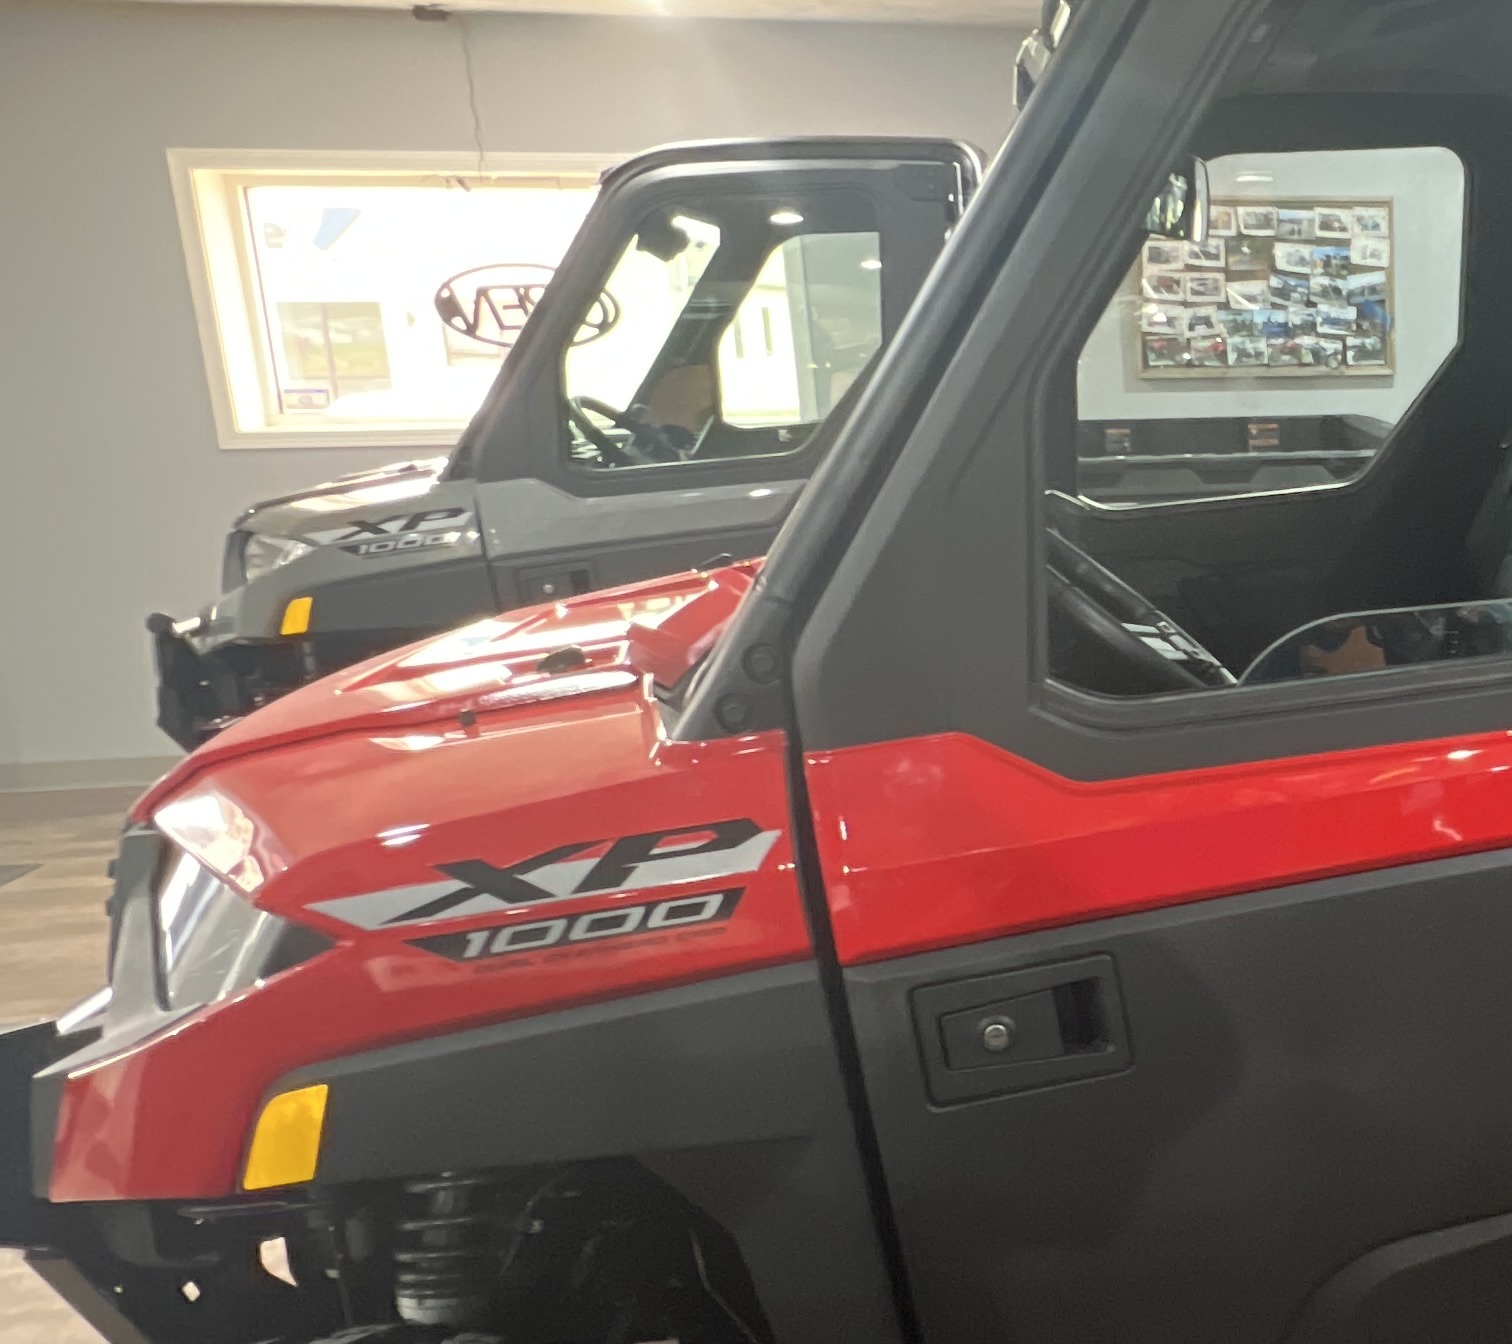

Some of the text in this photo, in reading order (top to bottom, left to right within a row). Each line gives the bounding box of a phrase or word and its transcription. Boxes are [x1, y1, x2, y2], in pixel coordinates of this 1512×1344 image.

[333, 507, 467, 542] XP
[377, 817, 765, 926] XP
[462, 893, 724, 959] 1000
